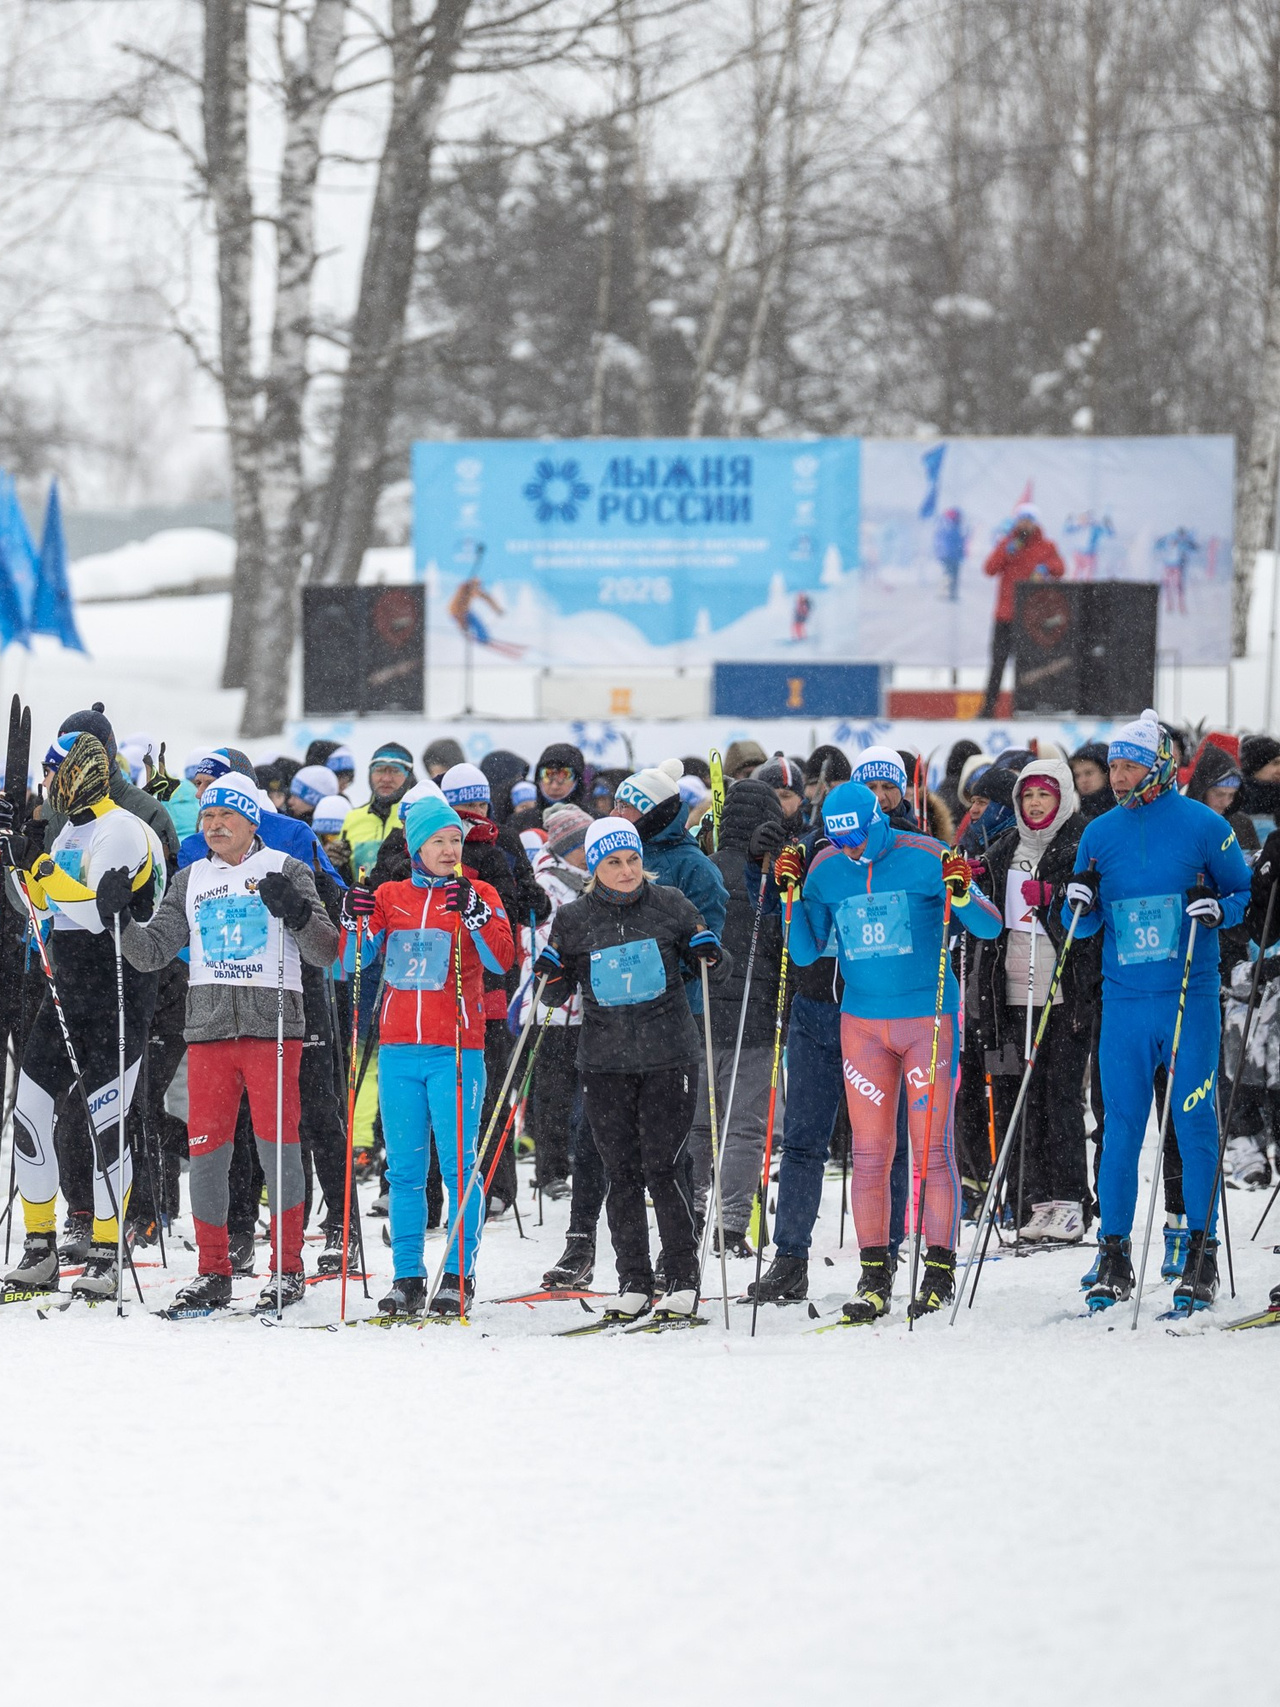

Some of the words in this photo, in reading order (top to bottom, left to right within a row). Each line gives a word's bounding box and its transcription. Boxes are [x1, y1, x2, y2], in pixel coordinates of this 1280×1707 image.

[600, 455, 754, 488] ЛЫЖНЯ
[598, 493, 753, 526] РОССИИ
[827, 815, 856, 830] DKB
[194, 885, 228, 905] ЛЫЖНЯ
[220, 924, 243, 946] 14
[862, 922, 885, 945] 88
[1134, 926, 1160, 949] 36
[405, 958, 427, 977] 21
[778, 946, 789, 978] LEKI
[937, 947, 947, 977] LEKI
[214, 970, 252, 979] ОБЛАСТЬ
[621, 973, 632, 993] 7
[843, 1059, 886, 1107] LUKOIL
[1183, 1070, 1215, 1112] OW
[177, 1309, 207, 1318] salomon
